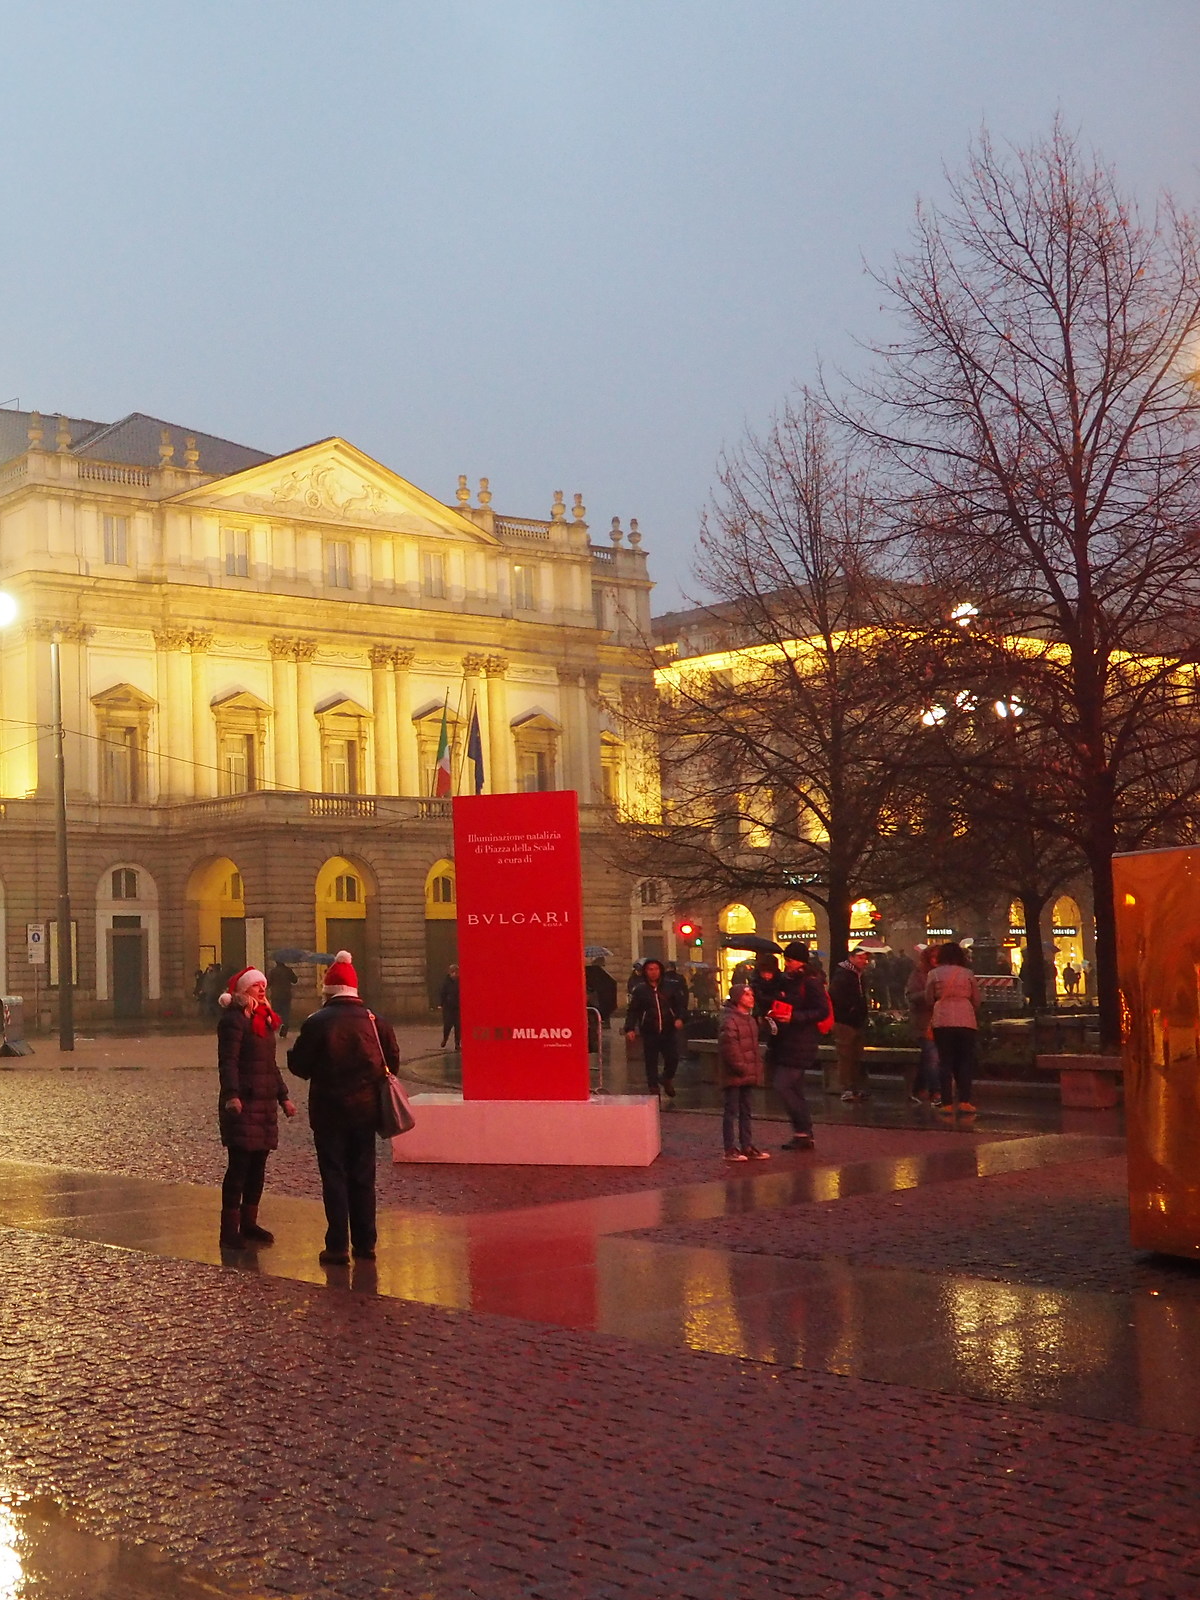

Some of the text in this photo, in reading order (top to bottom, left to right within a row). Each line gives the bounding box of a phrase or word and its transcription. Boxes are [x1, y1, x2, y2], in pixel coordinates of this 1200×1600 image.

[467, 830, 561, 843] Illuminazione natalizia
[475, 842, 555, 854] di Piazza della Scala
[523, 854, 532, 863] di
[467, 911, 569, 925] BVLGARI
[512, 1028, 572, 1039] MILANO
